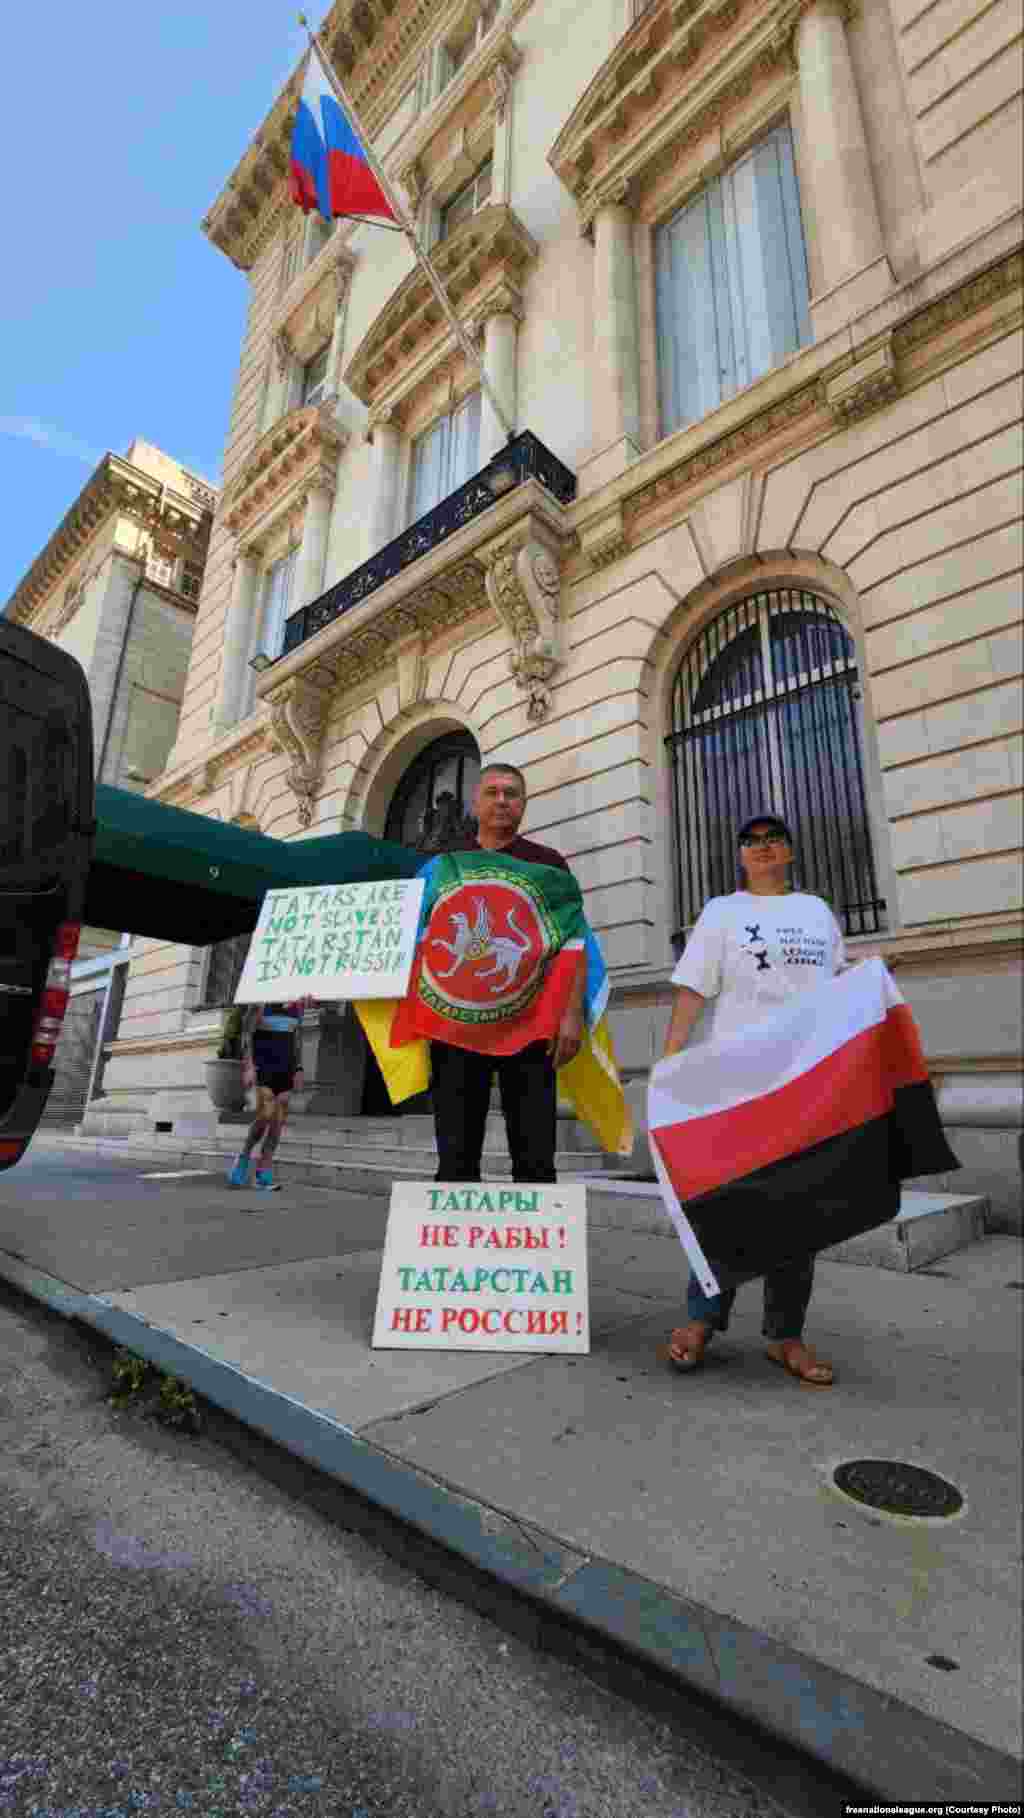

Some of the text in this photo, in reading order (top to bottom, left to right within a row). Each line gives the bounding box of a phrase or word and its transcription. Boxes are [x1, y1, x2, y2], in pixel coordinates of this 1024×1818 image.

[271, 883, 408, 912] TATARS ARE
[267, 911, 315, 935] NOT
[261, 928, 402, 957] TATARSTAN
[256, 959, 284, 983] IS
[288, 953, 331, 976] NOT
[426, 1190, 541, 1212] ТАТАРЫ
[419, 1225, 459, 1248] НЕ
[469, 1226, 550, 1249] РАБЫ
[398, 1267, 574, 1293] ТАТАРСТАН
[391, 1307, 433, 1333] НЕ
[441, 1308, 569, 1335] РОССИЯ
